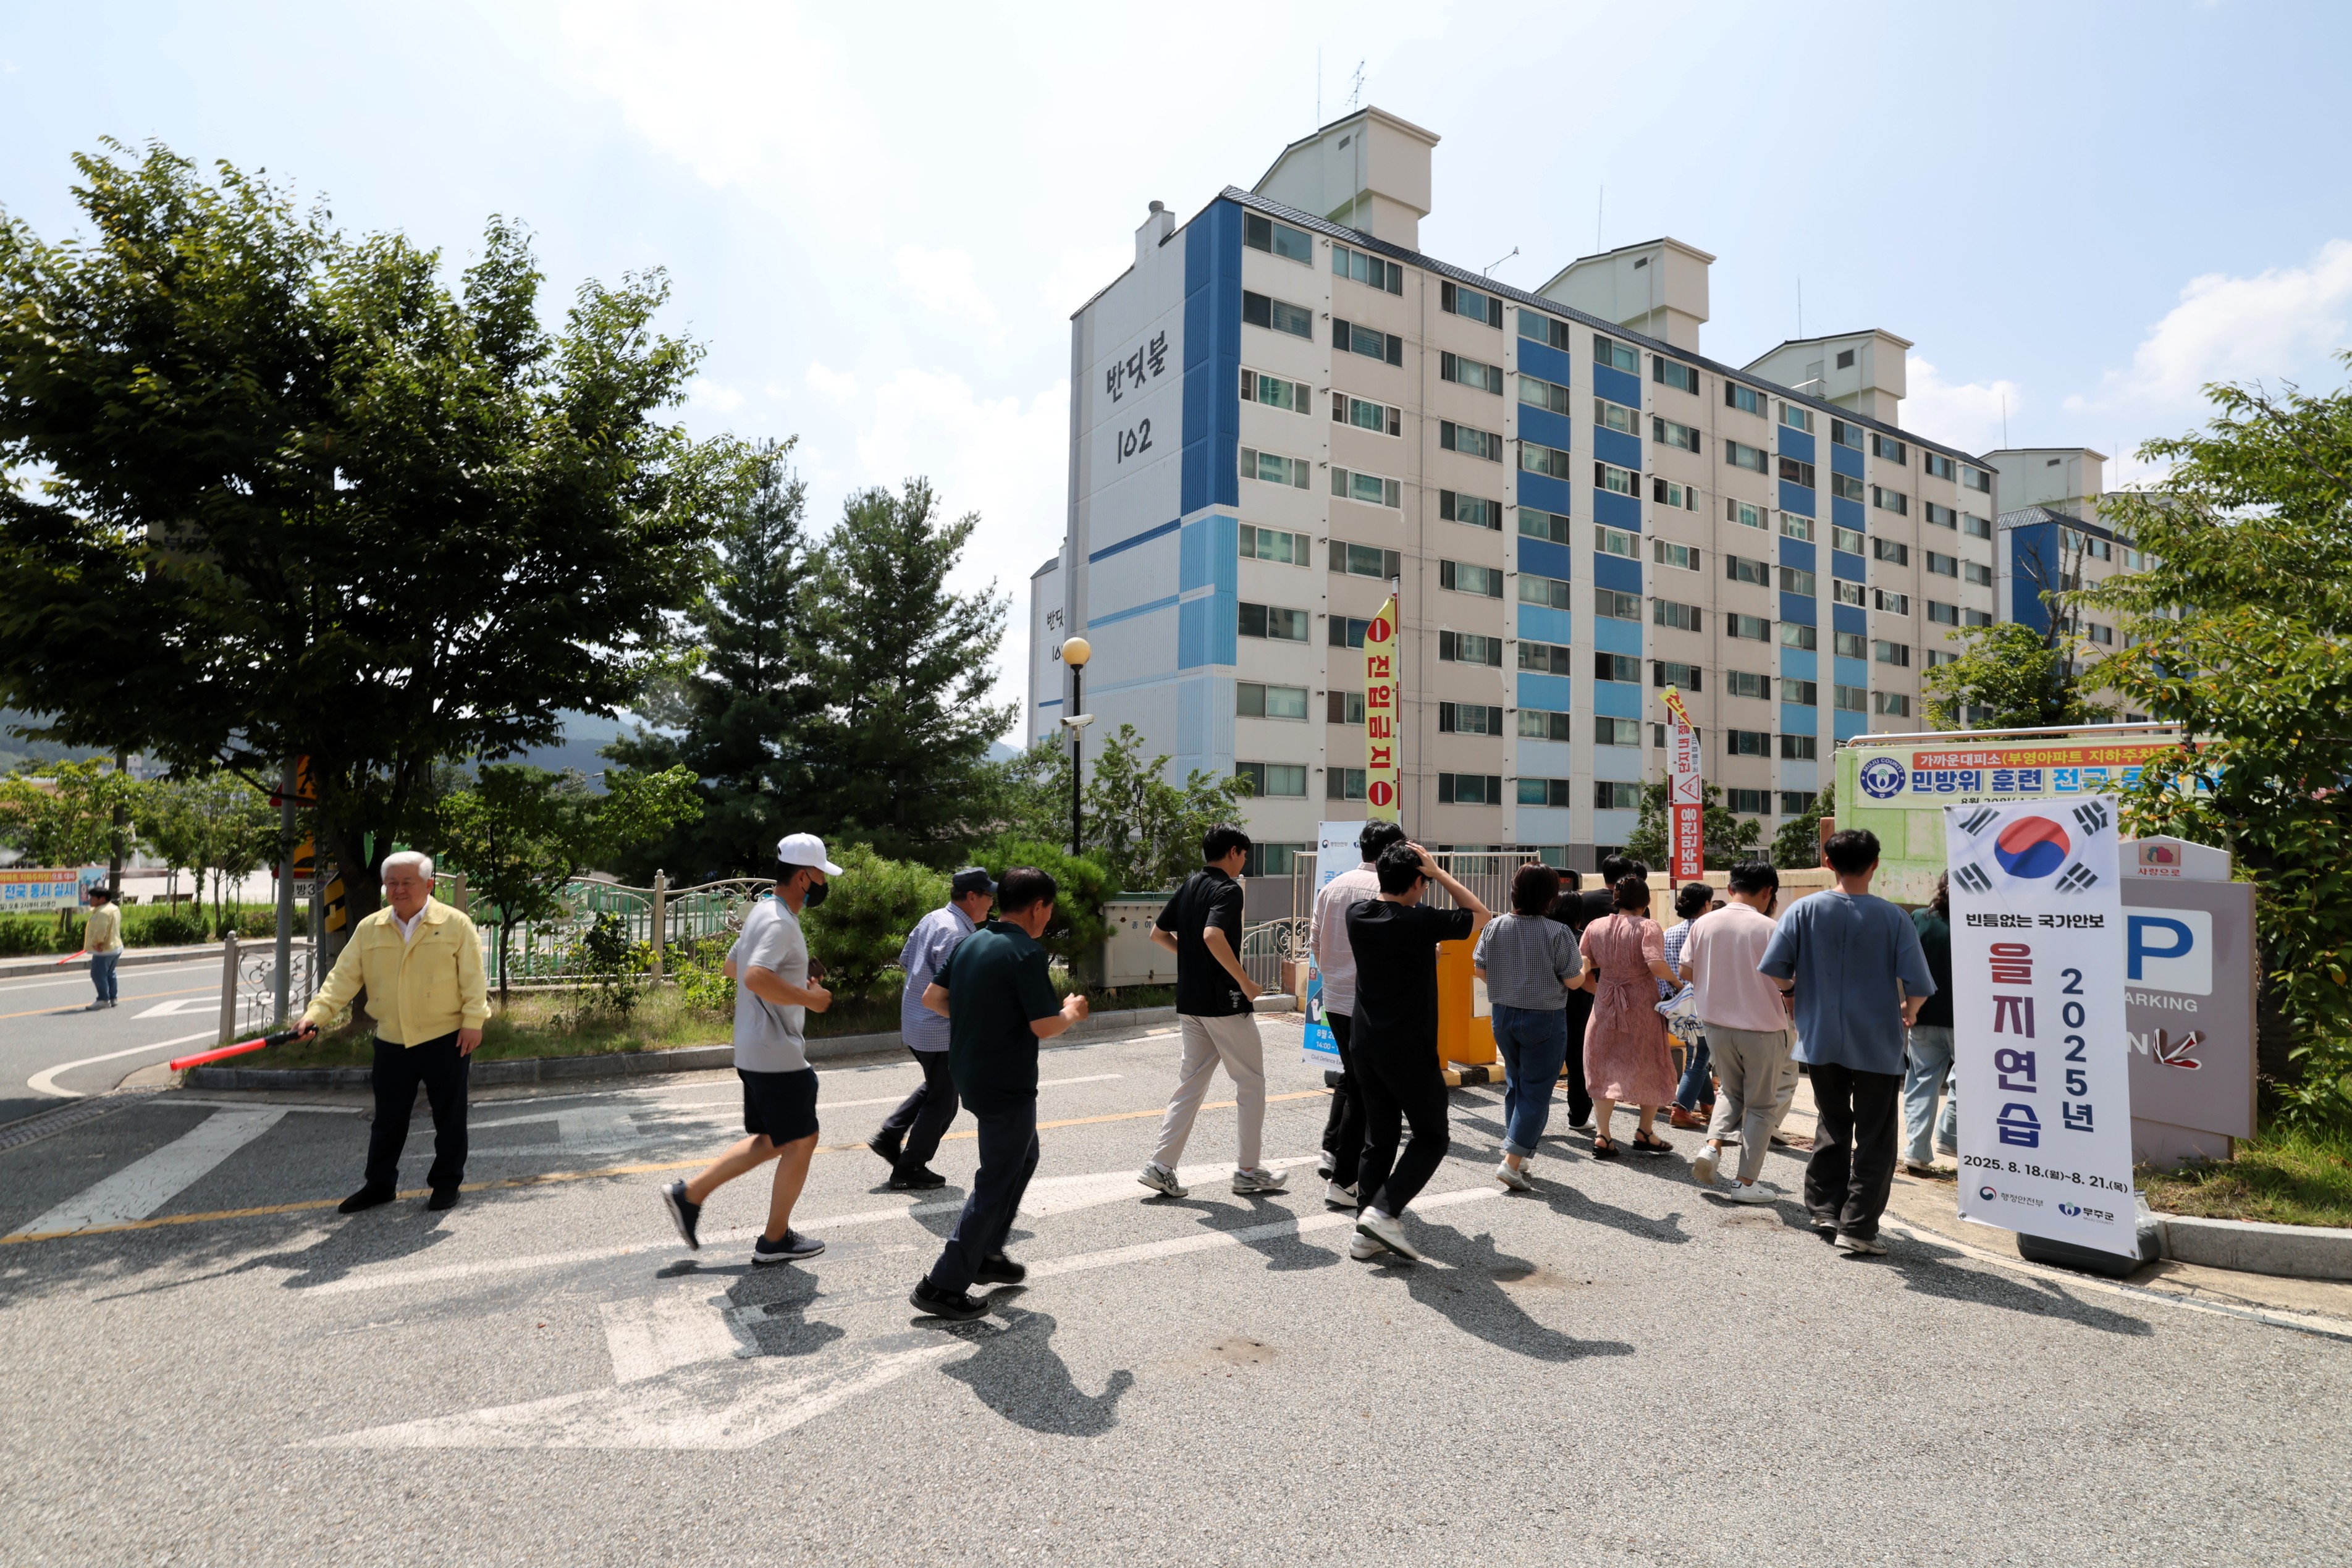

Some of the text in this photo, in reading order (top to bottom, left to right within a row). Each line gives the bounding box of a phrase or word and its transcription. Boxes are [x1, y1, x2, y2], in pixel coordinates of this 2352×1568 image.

[1107, 330, 1168, 403] 반딧불
[1118, 418, 1152, 464] 102
[1047, 607, 1066, 631] 반딧
[1052, 645, 1063, 662] 10
[1367, 655, 1391, 769] 진입금지
[1678, 738, 1690, 749] 내
[1678, 752, 1690, 773] 단지
[2088, 745, 2170, 764] 지하주차
[1863, 758, 1904, 773] MUJU COUNTY
[1912, 770, 1981, 792] 민방위
[1992, 769, 2042, 792] 훈련
[1681, 807, 1698, 875] 입주민전용
[2138, 867, 2181, 877] 사랑으로
[5, 884, 26, 900] 전국
[292, 883, 316, 896] 방3
[1966, 913, 2105, 929] 빈틈없는 국가안보
[2127, 915, 2194, 980] P
[2125, 992, 2198, 1013] ARKING
[1317, 1029, 1327, 1039] 8월
[2126, 1031, 2148, 1055] N
[1316, 1041, 1331, 1050] 14:00
[1989, 943, 2041, 1149] 을지연습
[2061, 968, 2094, 1132] 2025년
[1320, 1056, 1336, 1064] Defence
[1963, 1155, 2004, 1171] 2025.
[2008, 1161, 2021, 1174] 8.
[2089, 1176, 2128, 1194] 21.(목)
[2000, 1192, 2044, 1208] 행정안전부
[2083, 1207, 2114, 1222] 무주군
